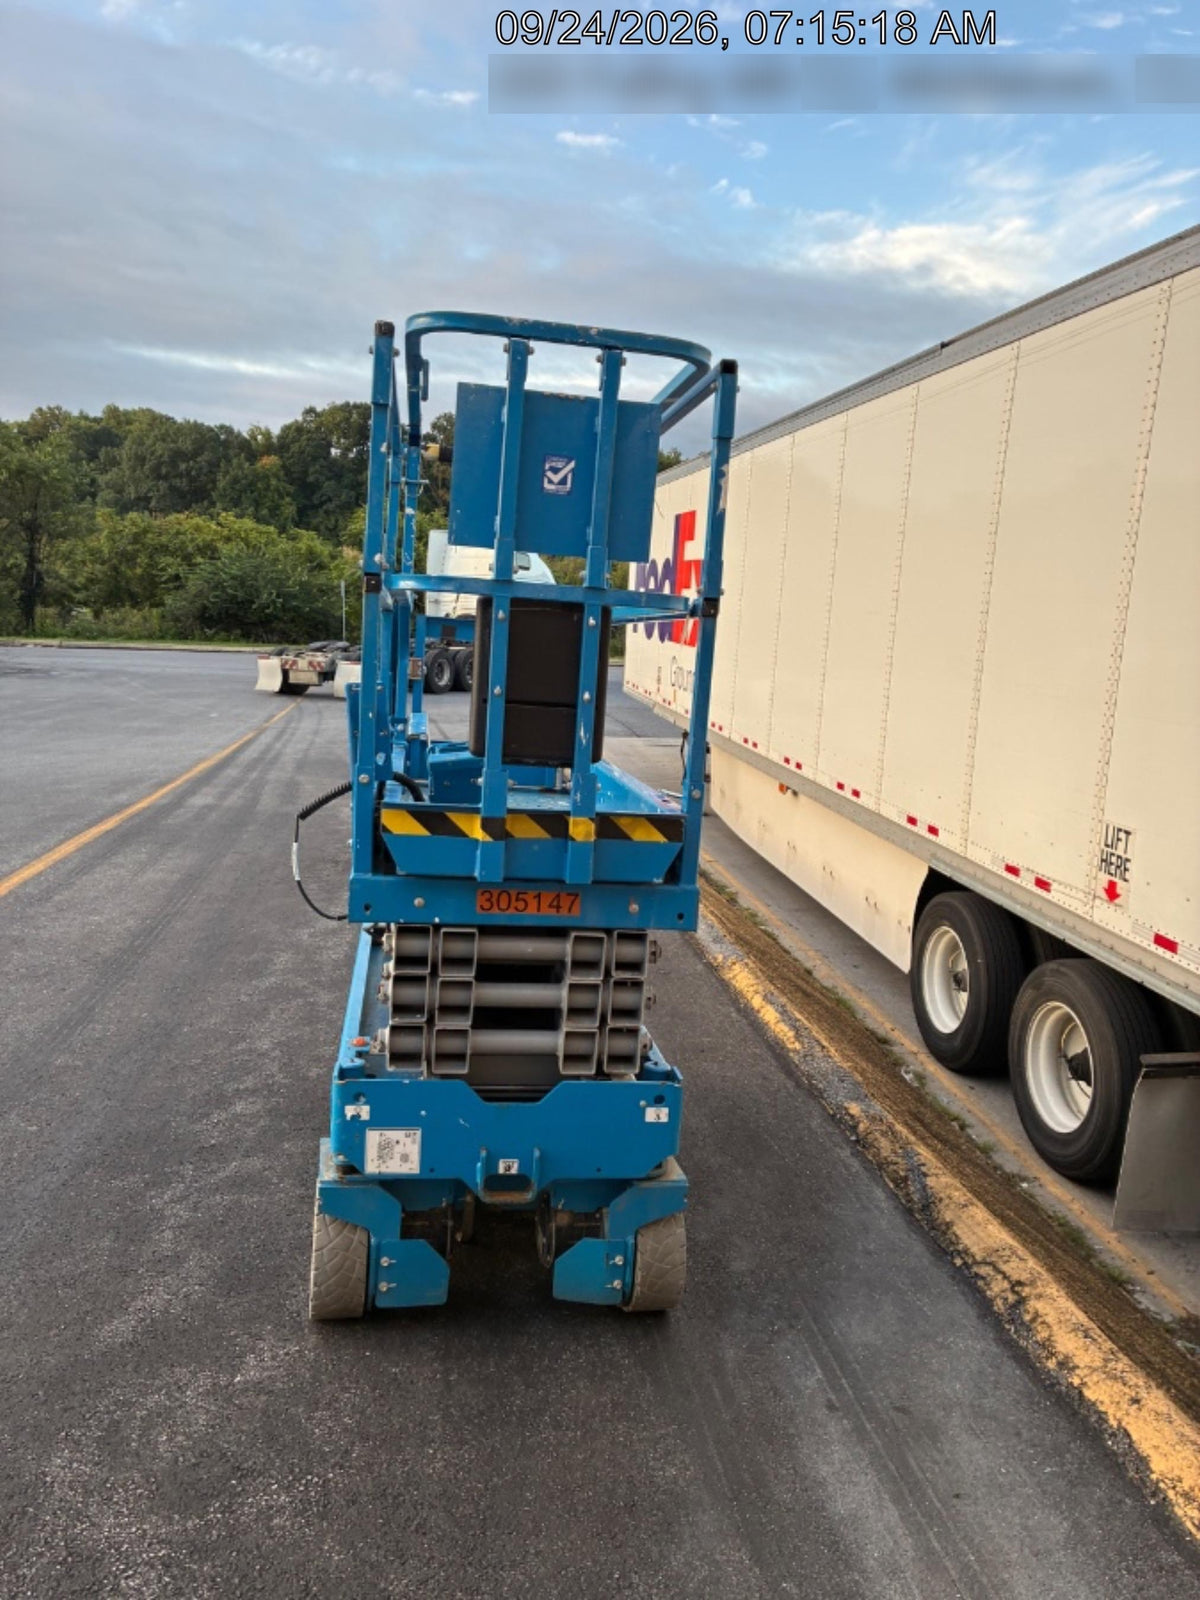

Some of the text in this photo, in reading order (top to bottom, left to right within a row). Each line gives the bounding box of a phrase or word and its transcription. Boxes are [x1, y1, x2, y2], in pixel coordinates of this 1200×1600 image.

[1104, 824, 1132, 855] LIFT
[1098, 849, 1131, 882] HERE
[479, 889, 580, 915] 305147
